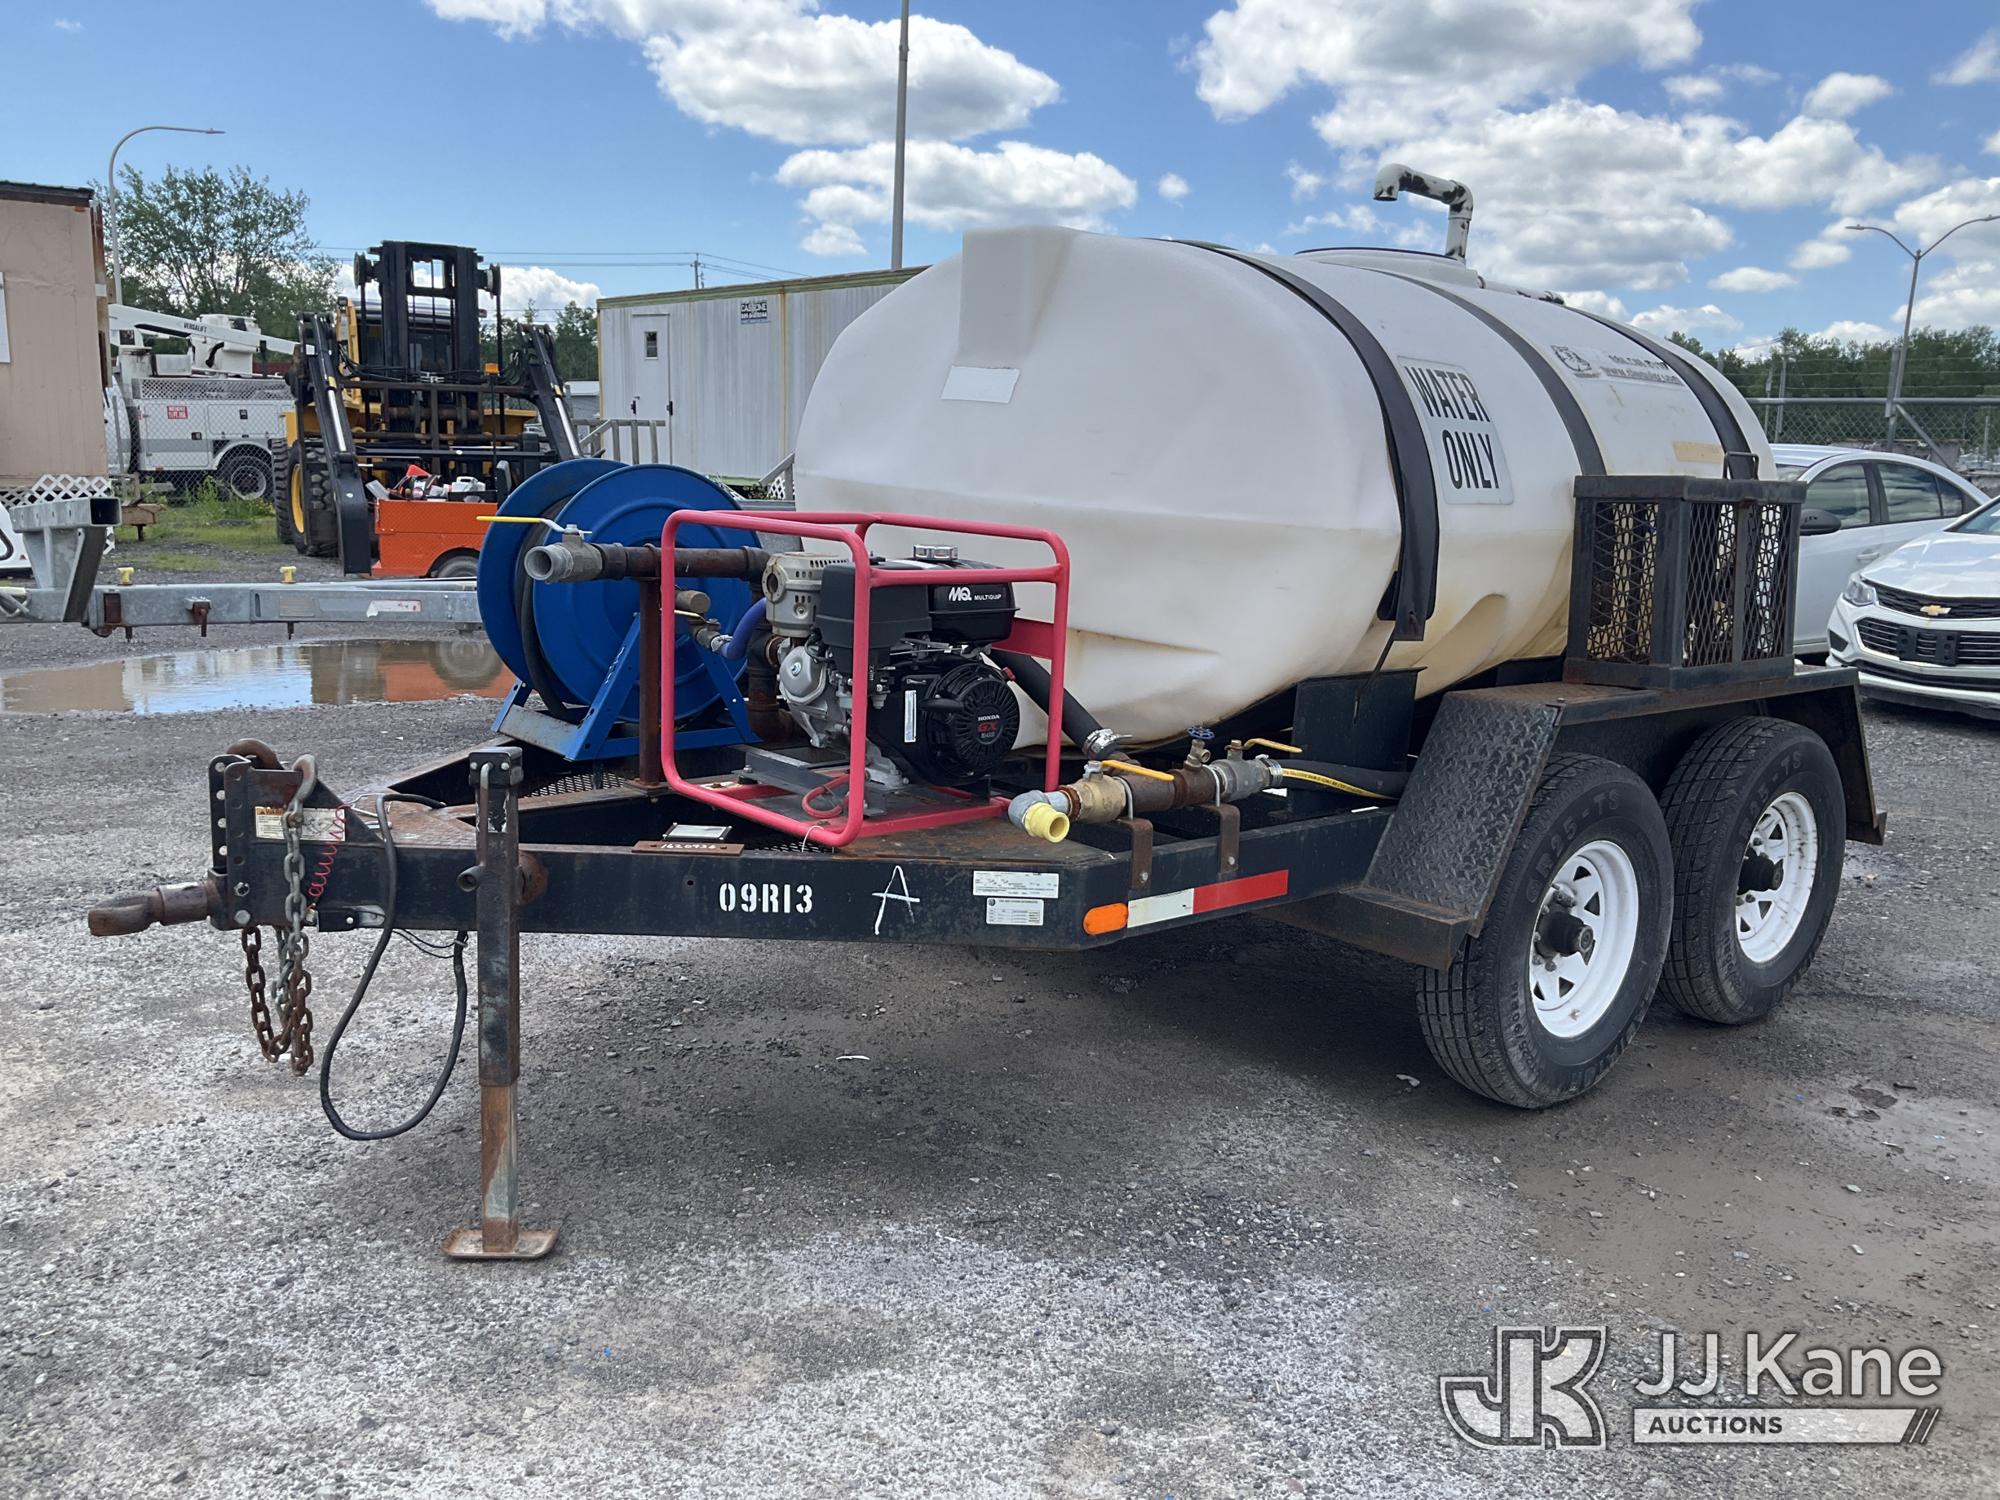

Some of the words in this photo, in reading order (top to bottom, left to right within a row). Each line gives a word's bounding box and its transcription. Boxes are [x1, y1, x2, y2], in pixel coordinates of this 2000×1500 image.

[1404, 366, 1491, 422] WATER
[1442, 429, 1500, 489] ONLY
[948, 586, 972, 602] MQ
[719, 883, 813, 914] 09R13
[872, 865, 920, 935] A
